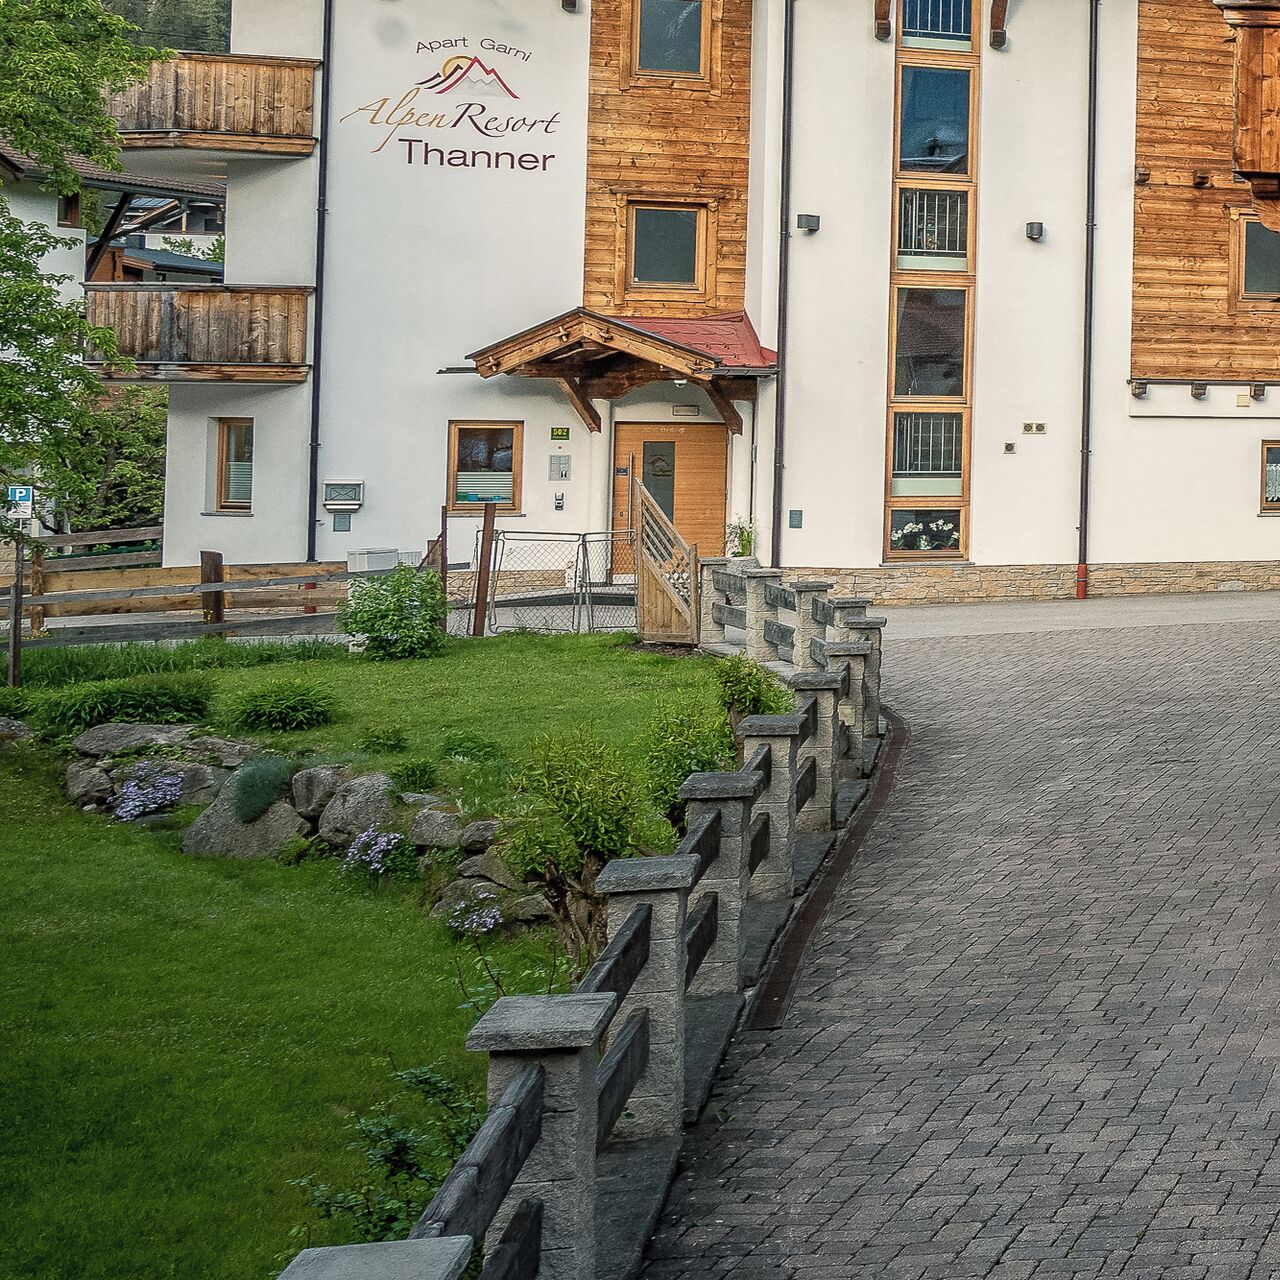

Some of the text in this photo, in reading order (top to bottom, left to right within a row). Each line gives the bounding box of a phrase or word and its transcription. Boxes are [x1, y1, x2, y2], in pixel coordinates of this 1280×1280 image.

[415, 36, 533, 63] Apart Garni
[398, 138, 556, 171] Thanner
[553, 428, 567, 436] 502
[15, 488, 27, 501] P
